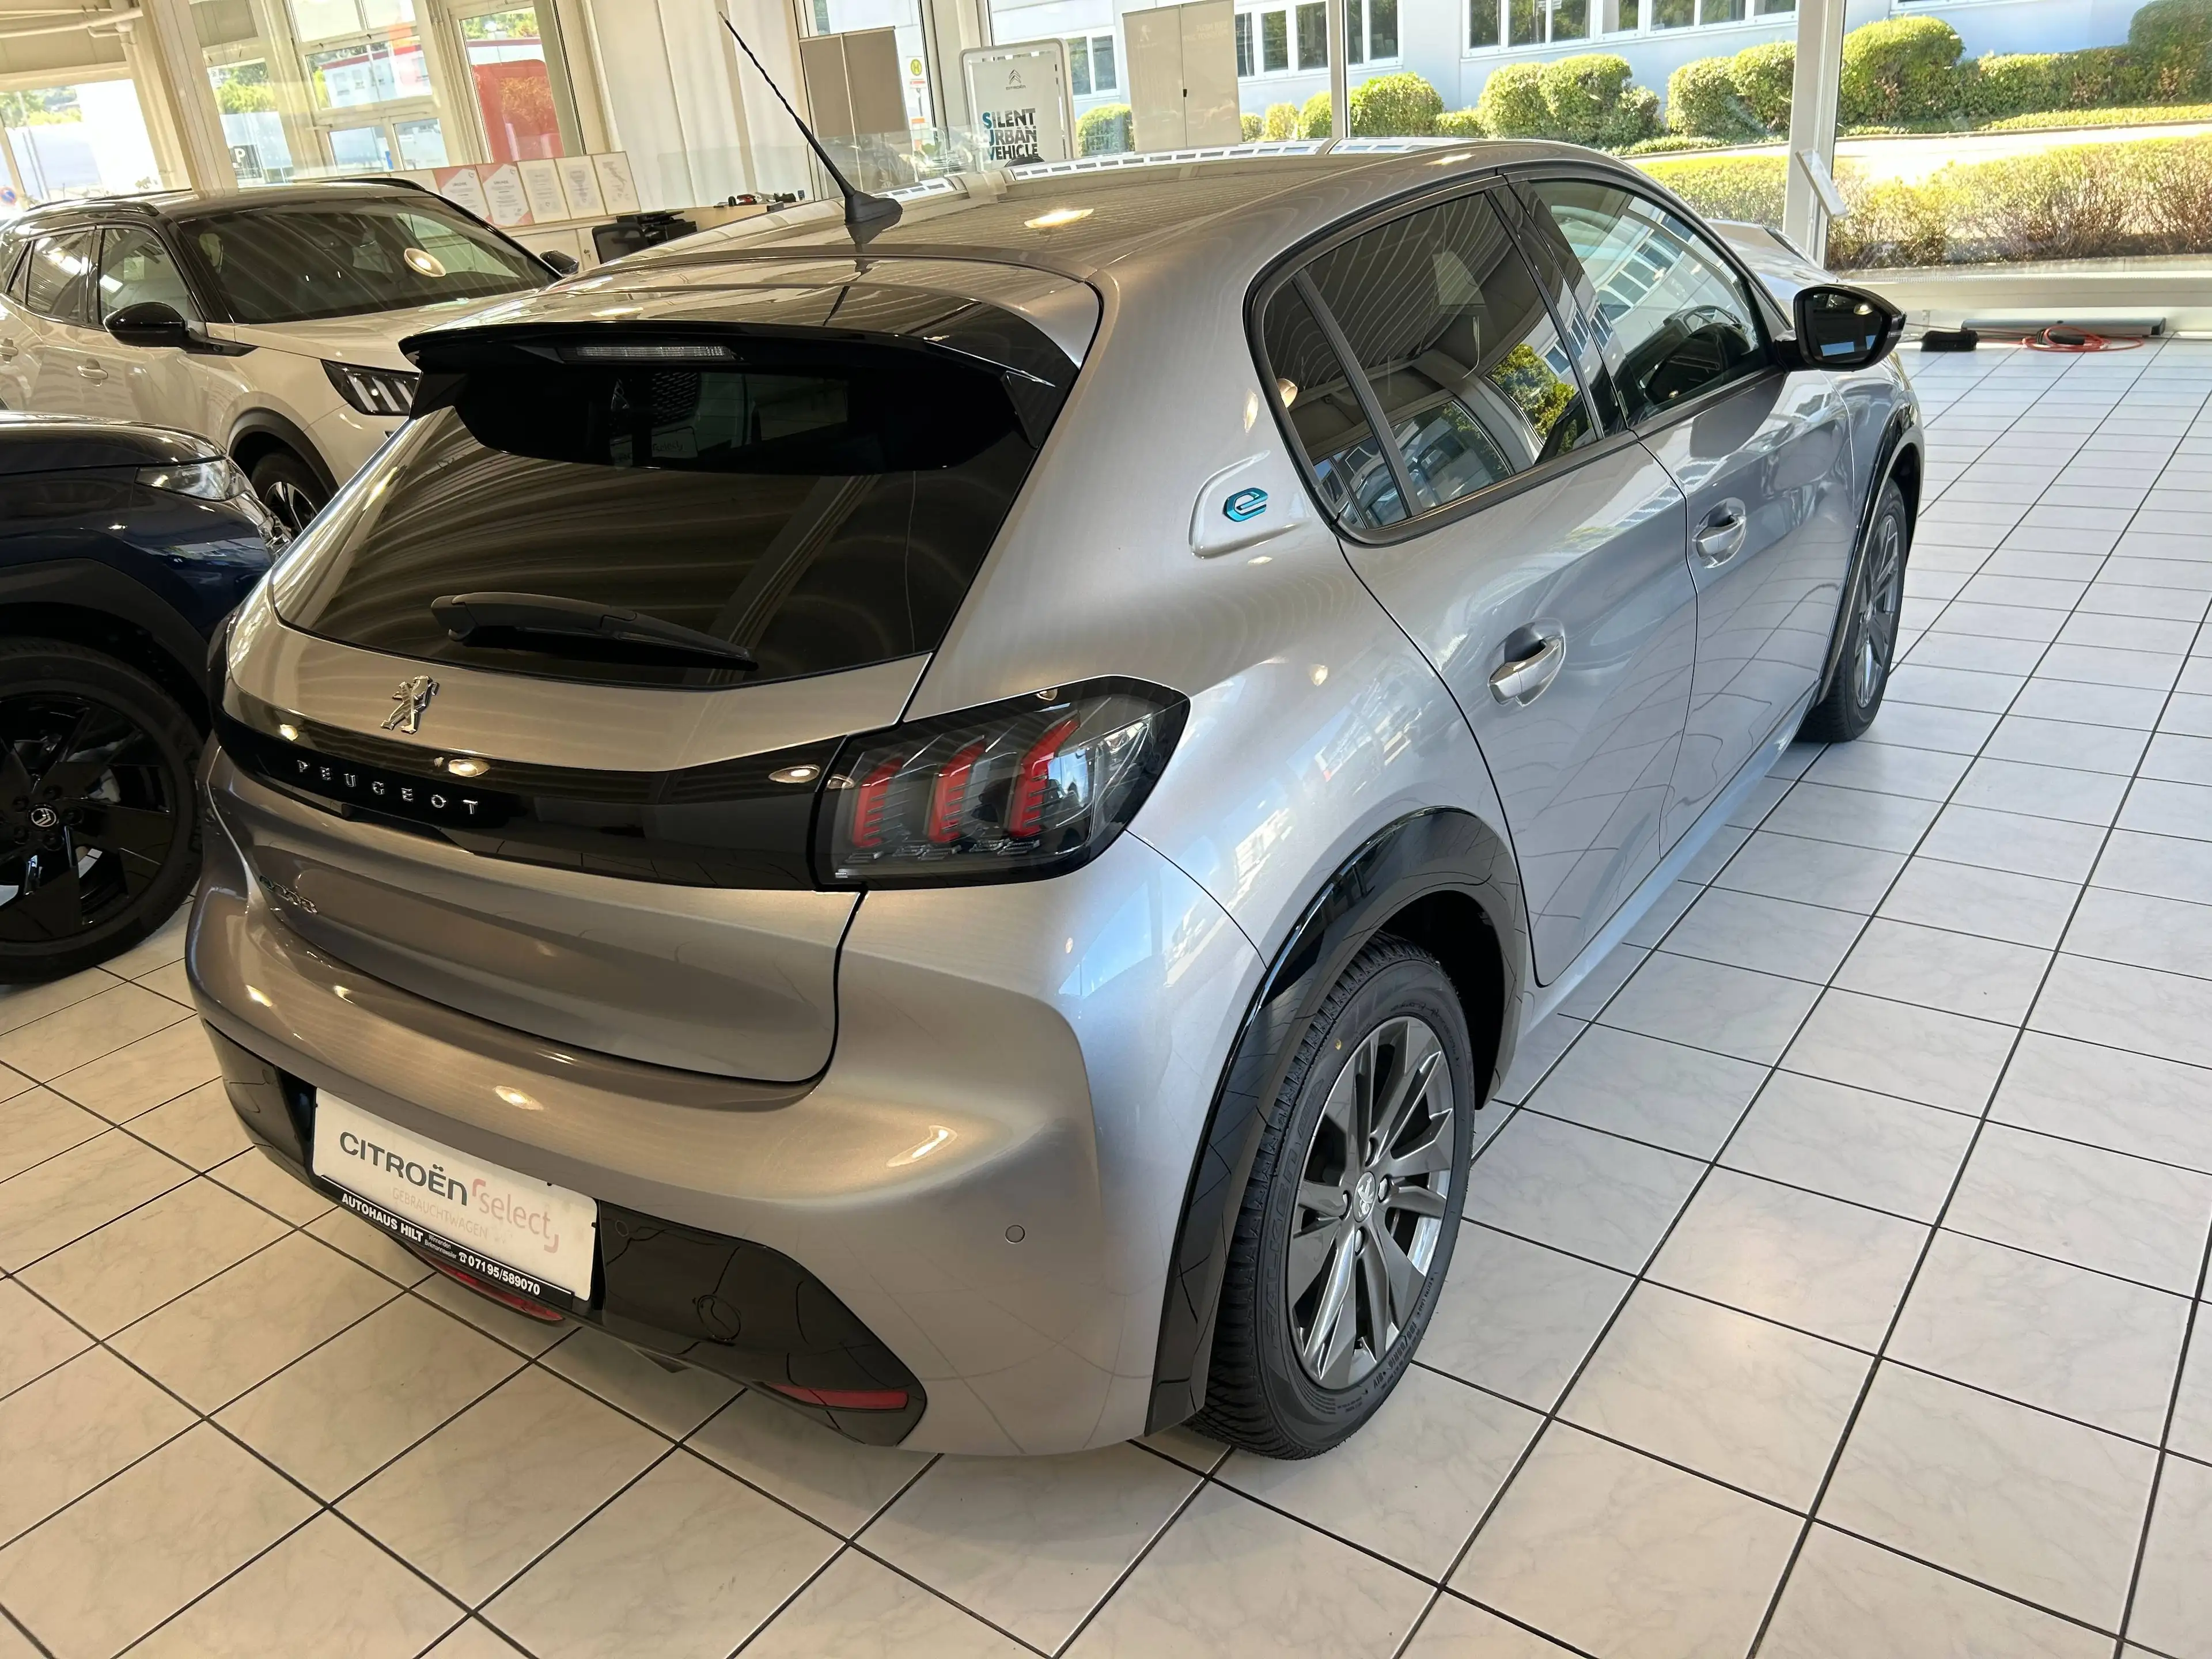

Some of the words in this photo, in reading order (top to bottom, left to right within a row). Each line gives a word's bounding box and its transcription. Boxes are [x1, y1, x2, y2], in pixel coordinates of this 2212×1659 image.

[982, 108, 1036, 129] SILENT
[234, 147, 246, 162] P
[987, 143, 1039, 161] VEHICLE
[296, 759, 479, 815] PEUGEOT
[342, 1192, 398, 1230] AUTOHAUS
[400, 1222, 424, 1243] HILT
[468, 1256, 541, 1296] 07195/589070
